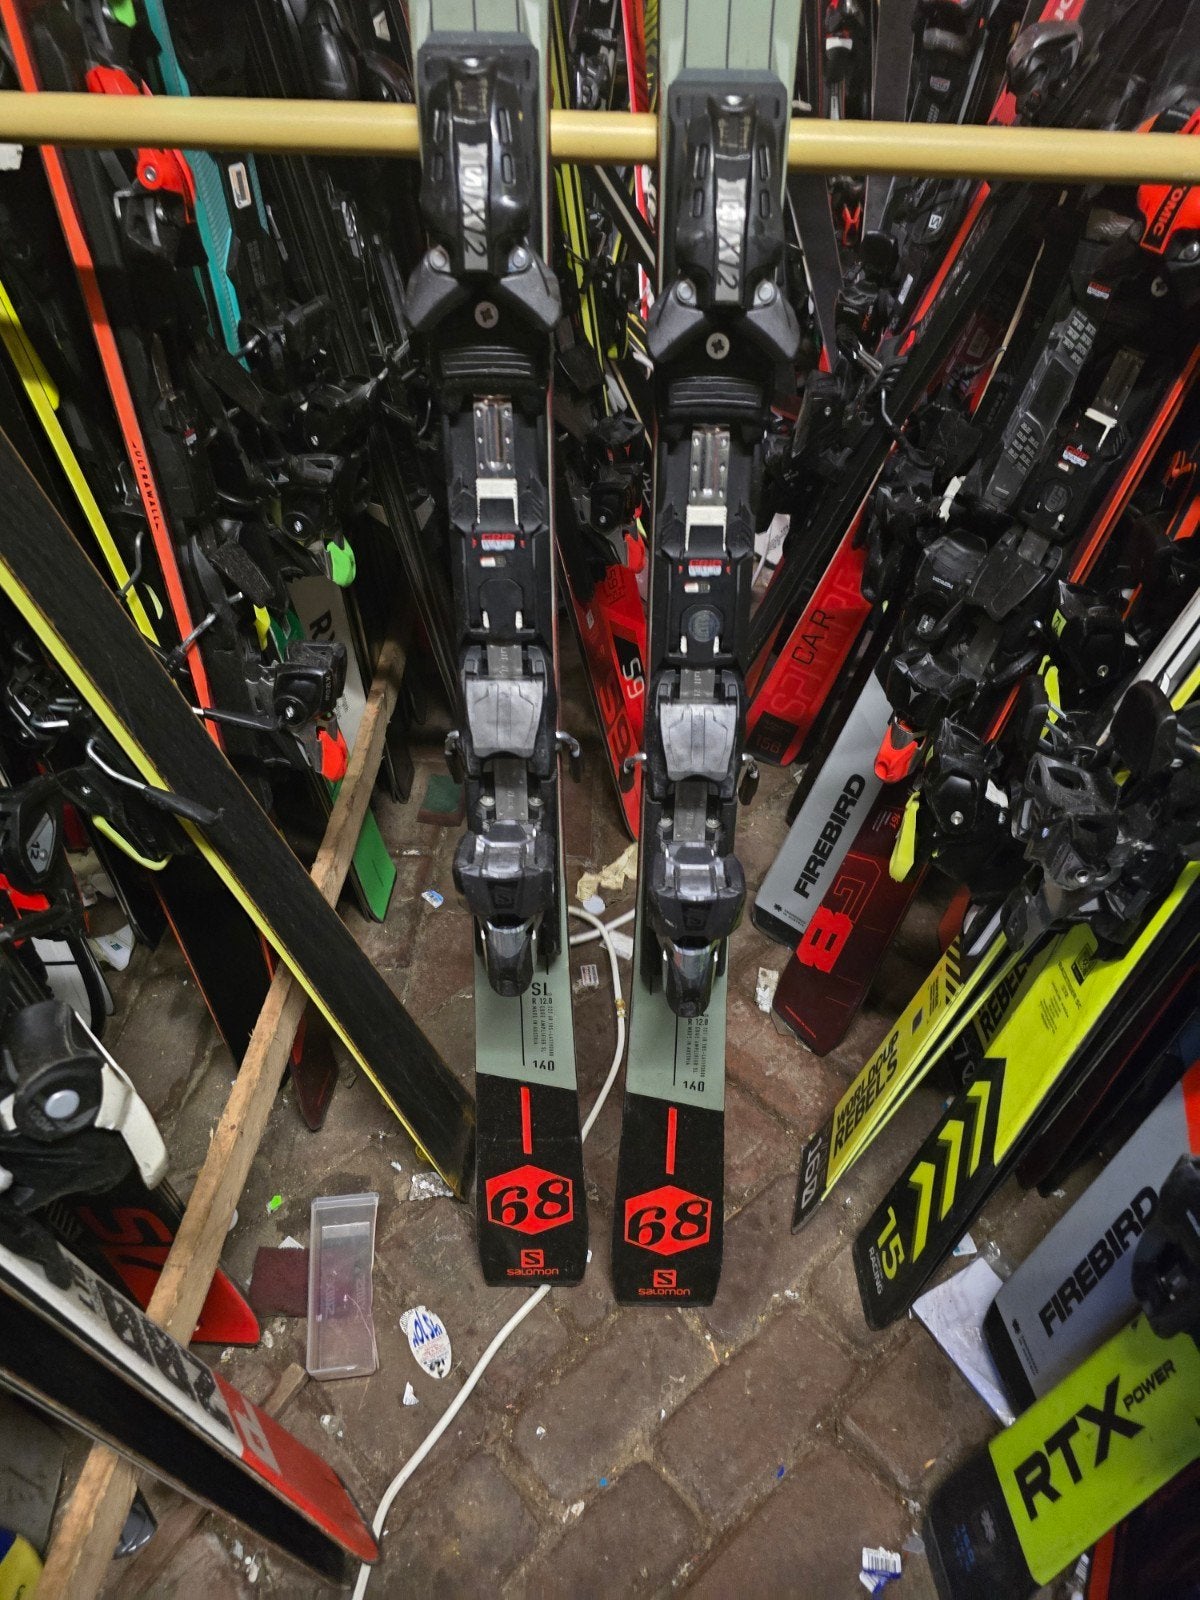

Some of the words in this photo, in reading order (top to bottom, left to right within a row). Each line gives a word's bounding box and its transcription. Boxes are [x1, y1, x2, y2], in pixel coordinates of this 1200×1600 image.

[1153, 186, 1187, 236] OMIC
[134, 450, 160, 521] ULTRAWALL
[793, 772, 866, 899] FIREBIRD
[532, 1060, 555, 1071] 140
[683, 1081, 705, 1092] 140
[837, 1031, 900, 1130] WORLDCUP
[834, 1049, 898, 1158] REBELS
[491, 1178, 570, 1226] 68
[628, 1200, 709, 1247] 68
[868, 1246, 884, 1295] RACING
[1038, 1186, 1159, 1338] FIREBIRD
[1122, 1358, 1177, 1412] POWER
[1013, 1373, 1146, 1522] RTX
